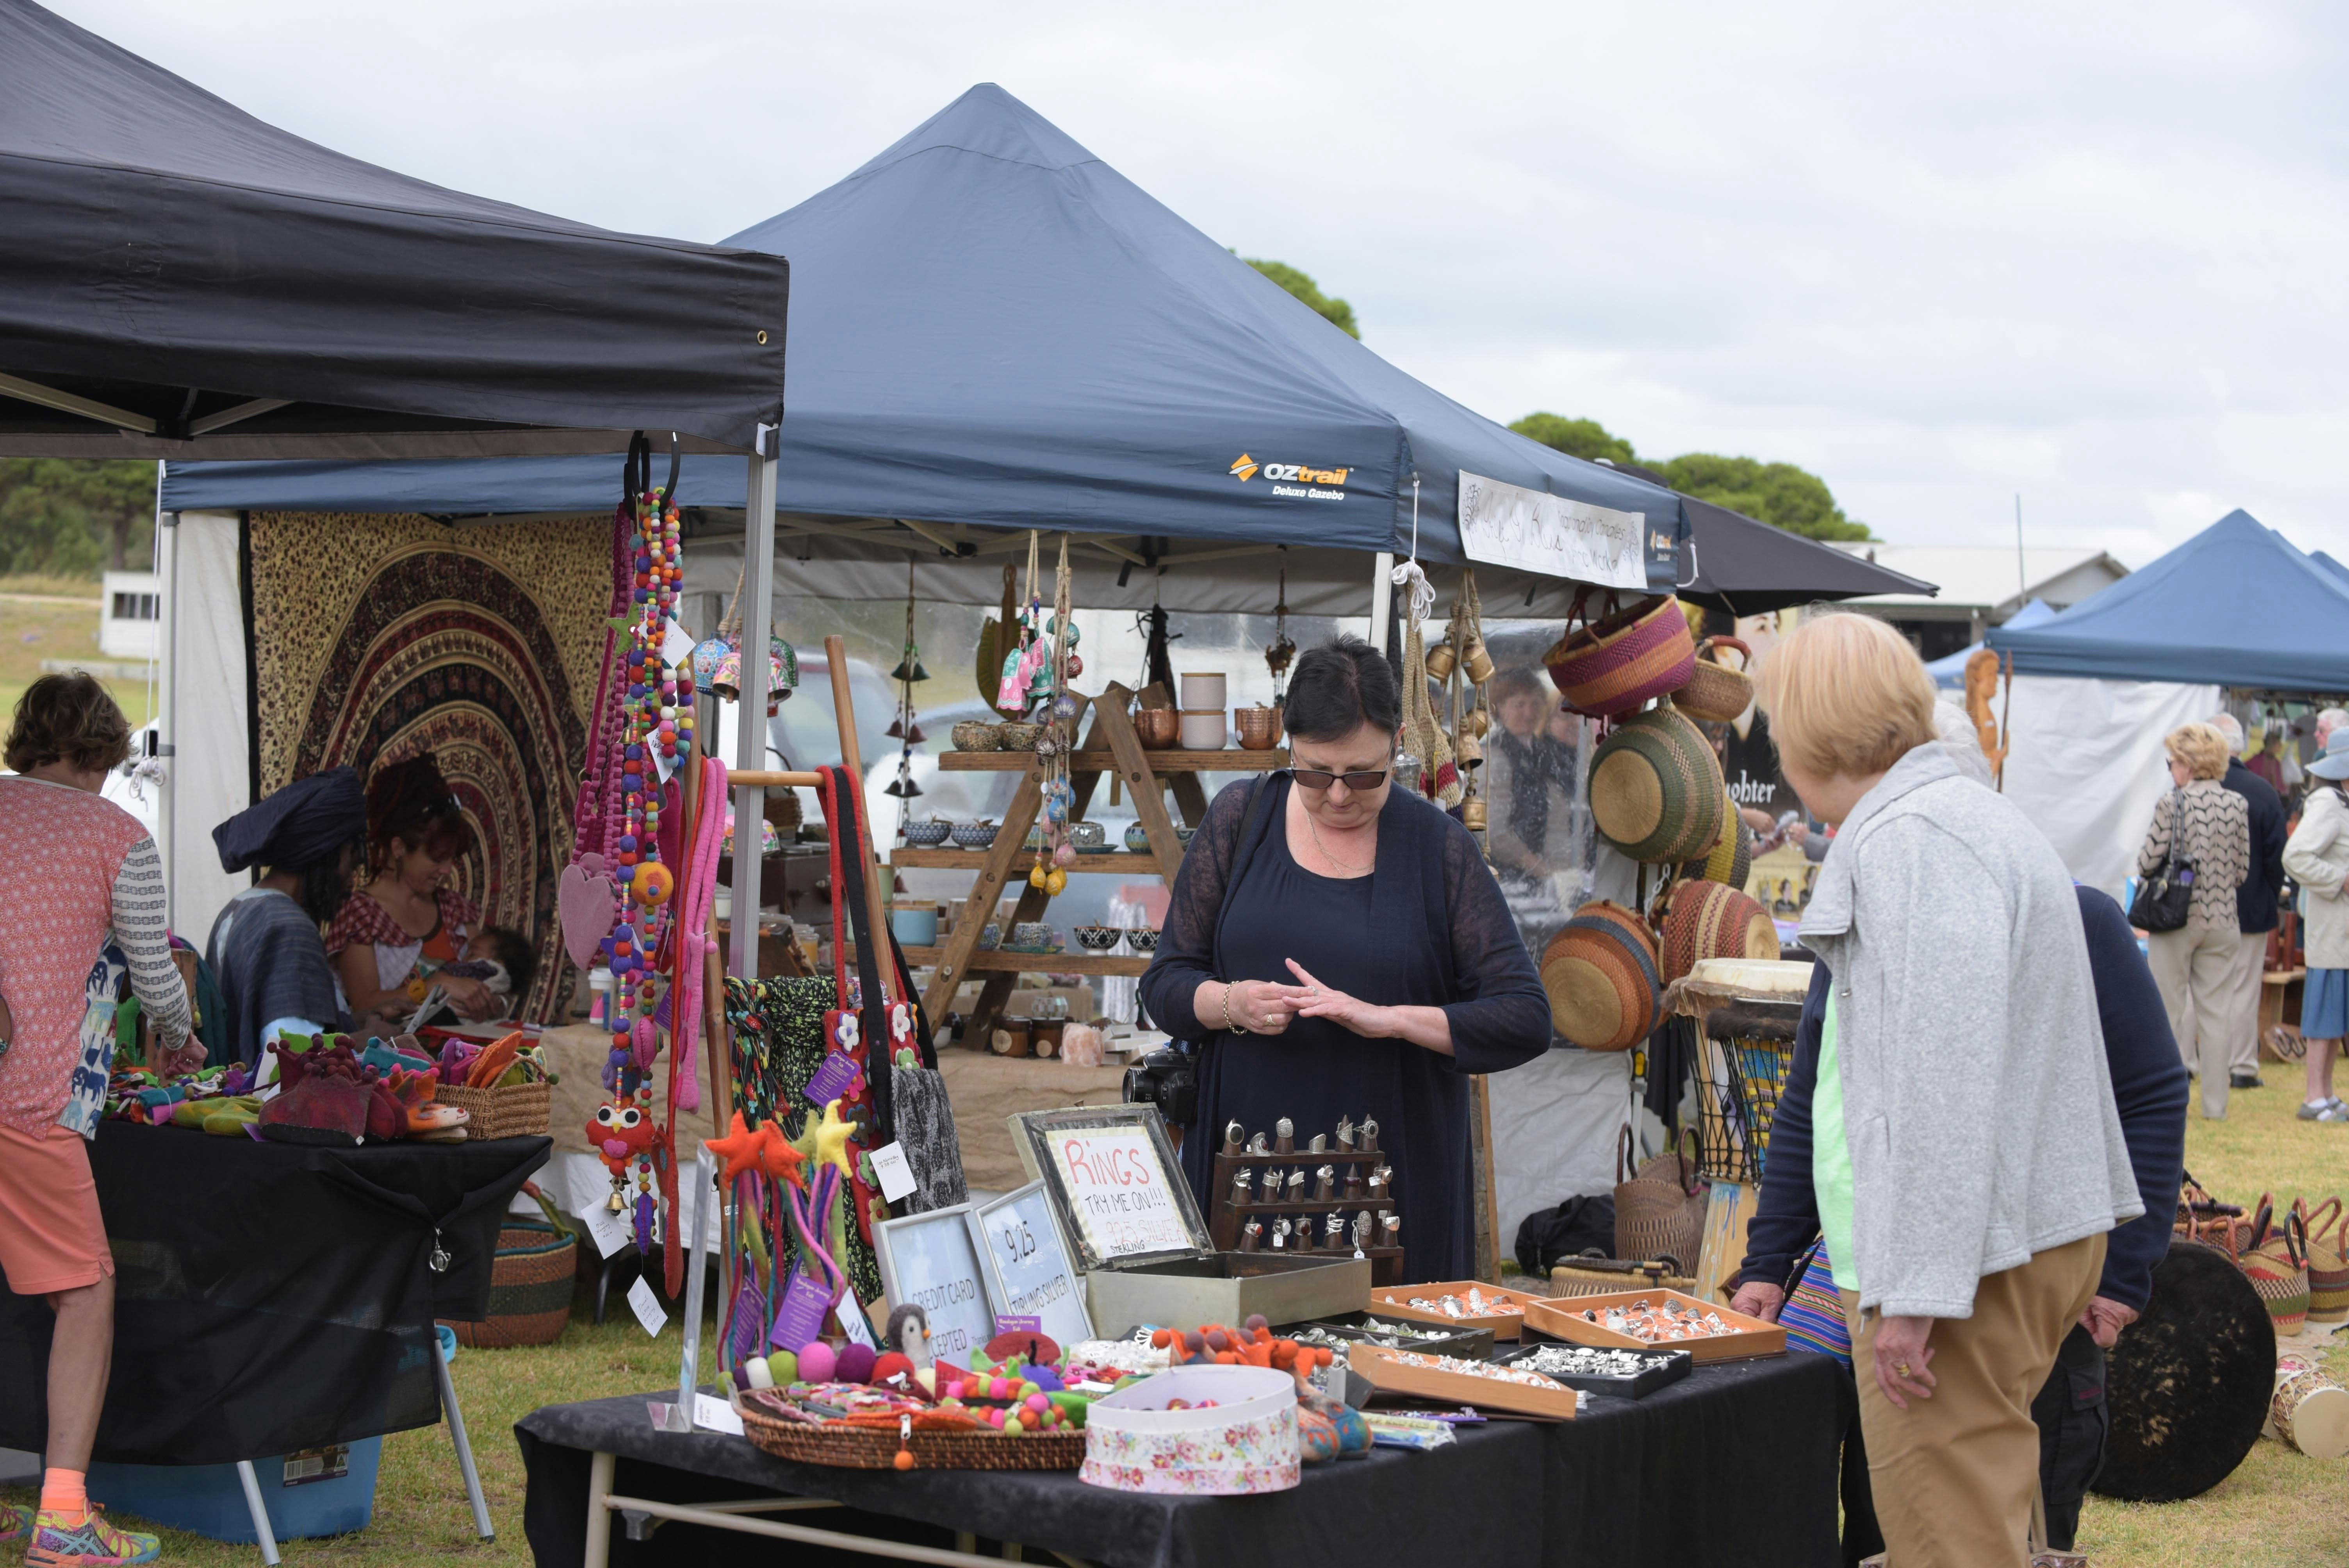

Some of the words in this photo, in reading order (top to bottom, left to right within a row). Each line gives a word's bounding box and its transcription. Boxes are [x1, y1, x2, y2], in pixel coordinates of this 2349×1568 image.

[1264, 463, 1348, 485] OZtrail
[1273, 485, 1306, 497] Deluxe
[1308, 488, 1344, 500] Gazebo
[1085, 1194, 1111, 1215] TRY
[1111, 1193, 1131, 1213] ME
[1005, 1221, 1035, 1263] 9.25
[1106, 1221, 1138, 1245] 925
[1139, 1216, 1189, 1244] SILVER
[1110, 1239, 1145, 1254] STERLING
[912, 1285, 947, 1312] CREDIT
[948, 1279, 975, 1304] CARD
[1042, 1274, 1069, 1304] SILVER
[930, 1329, 967, 1360] CEPTED
